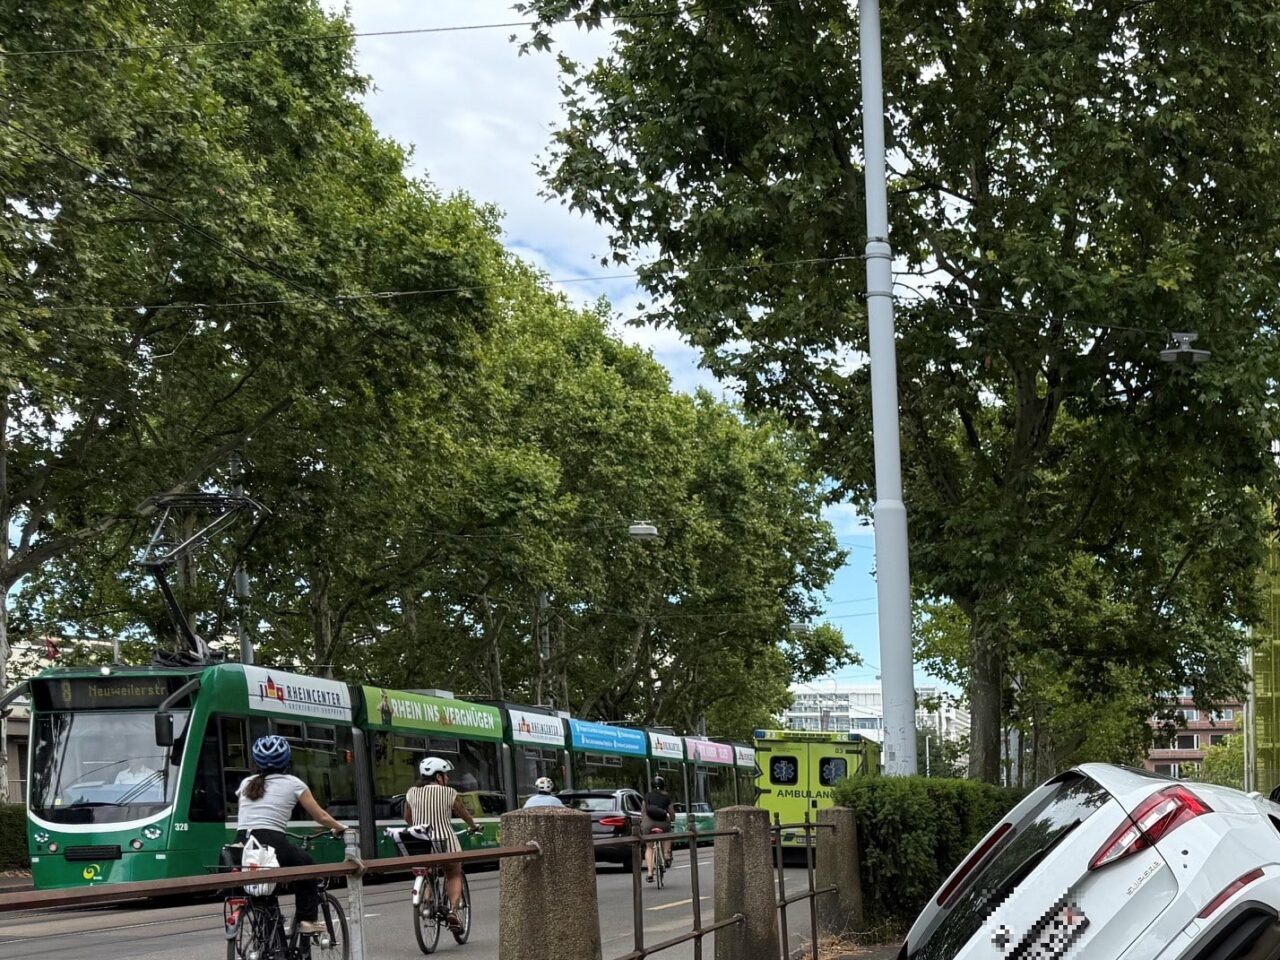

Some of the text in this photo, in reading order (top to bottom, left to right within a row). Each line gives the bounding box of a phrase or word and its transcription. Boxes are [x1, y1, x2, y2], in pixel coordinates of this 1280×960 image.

[62, 681, 72, 702] 8
[287, 686, 341, 706] RHEINCENTER
[391, 699, 495, 729] RHEIN INS VERGNÜGEN
